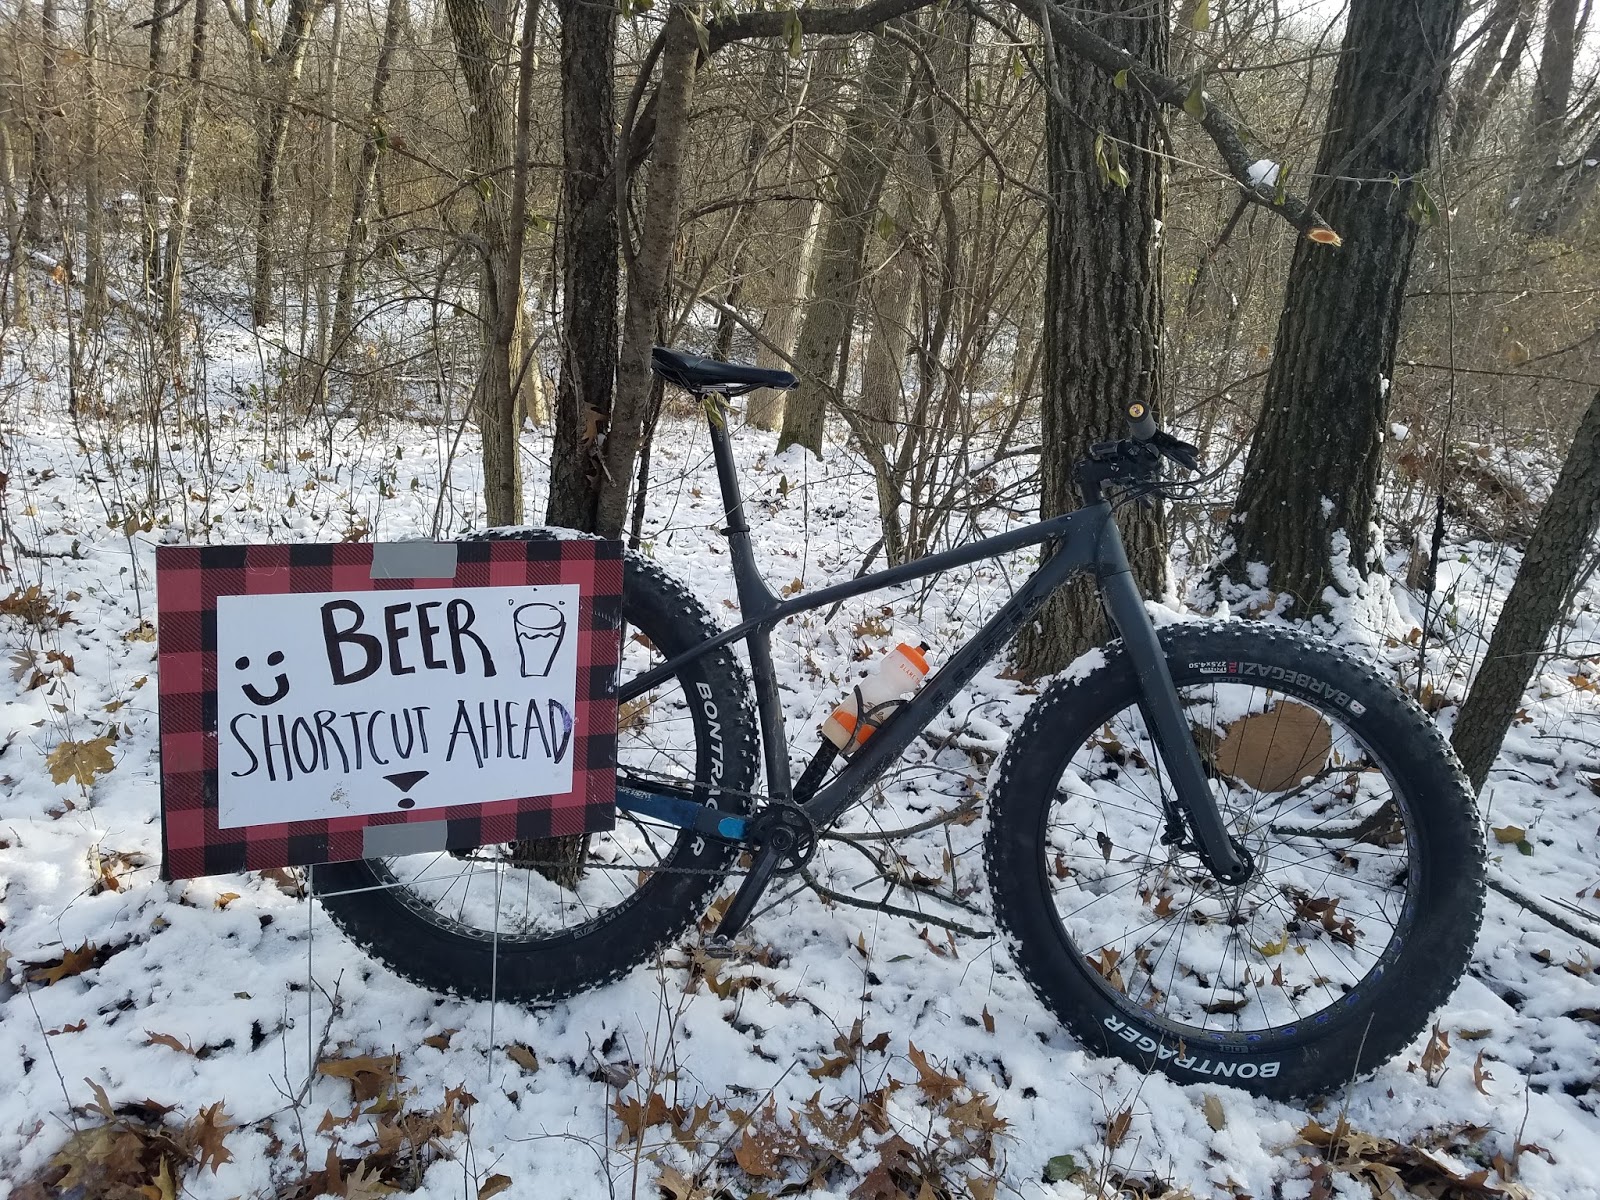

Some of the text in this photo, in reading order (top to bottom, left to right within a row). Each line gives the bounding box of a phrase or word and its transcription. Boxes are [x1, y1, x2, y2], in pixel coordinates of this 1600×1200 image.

[320, 599, 497, 685] BEER
[1238, 661, 1350, 707] BARBEGAZI
[230, 700, 573, 782] SHORTCUT AHEAD
[1103, 1015, 1281, 1079] BONTRAGER
